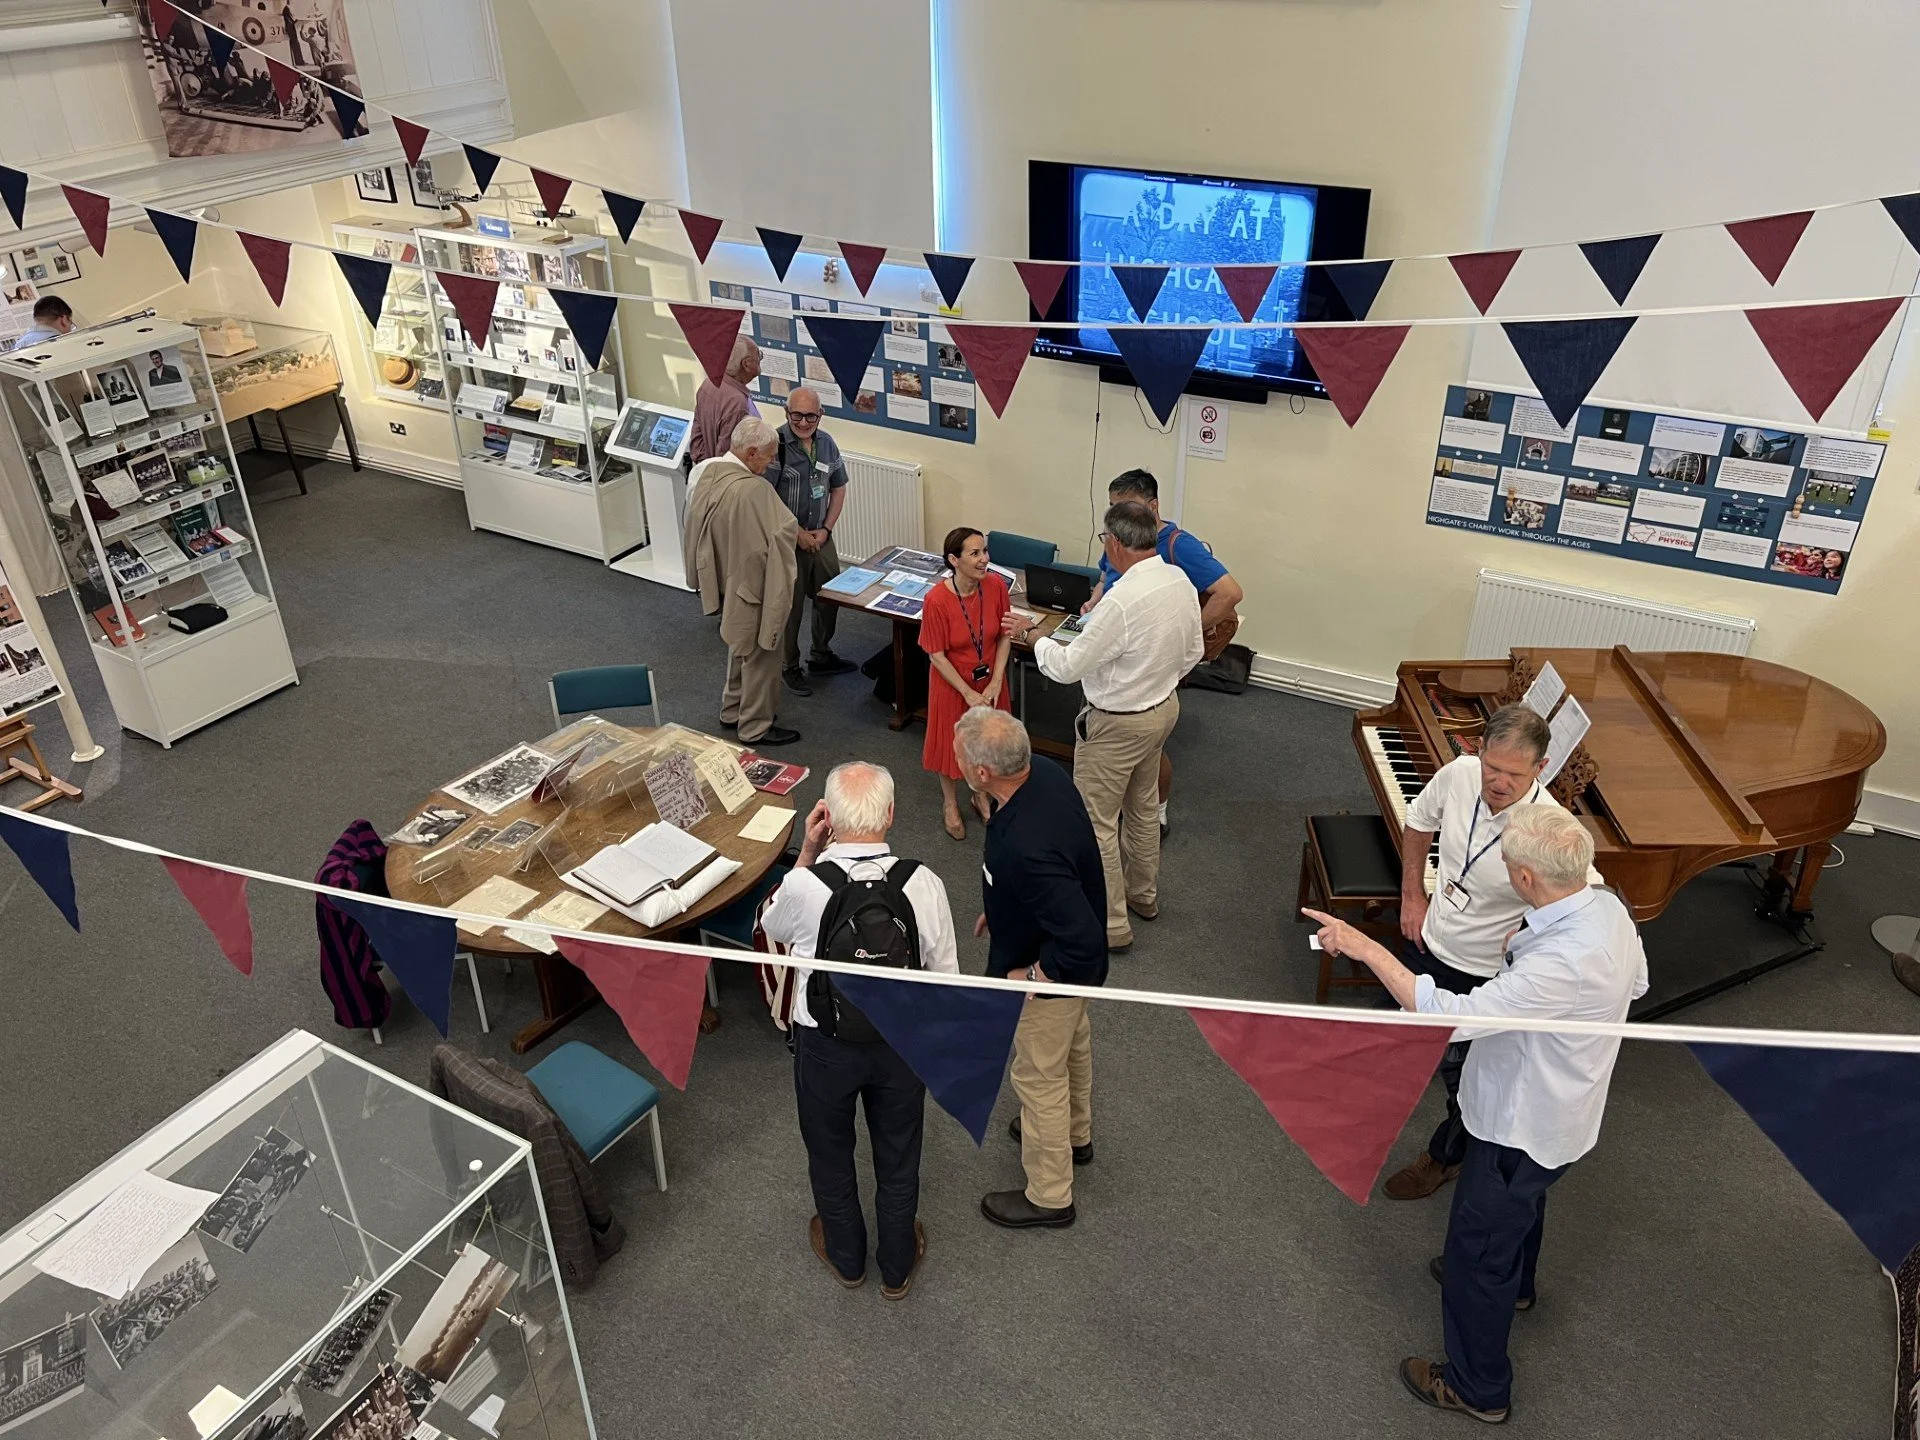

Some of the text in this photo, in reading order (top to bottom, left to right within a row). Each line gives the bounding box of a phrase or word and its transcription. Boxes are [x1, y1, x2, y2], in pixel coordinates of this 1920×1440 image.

[1229, 208, 1270, 241] AT
[1427, 515, 1591, 549] HIGHGATE’S CHARITY WORK THROUGH THE AGES
[1658, 536, 1695, 547] PHYSICS
